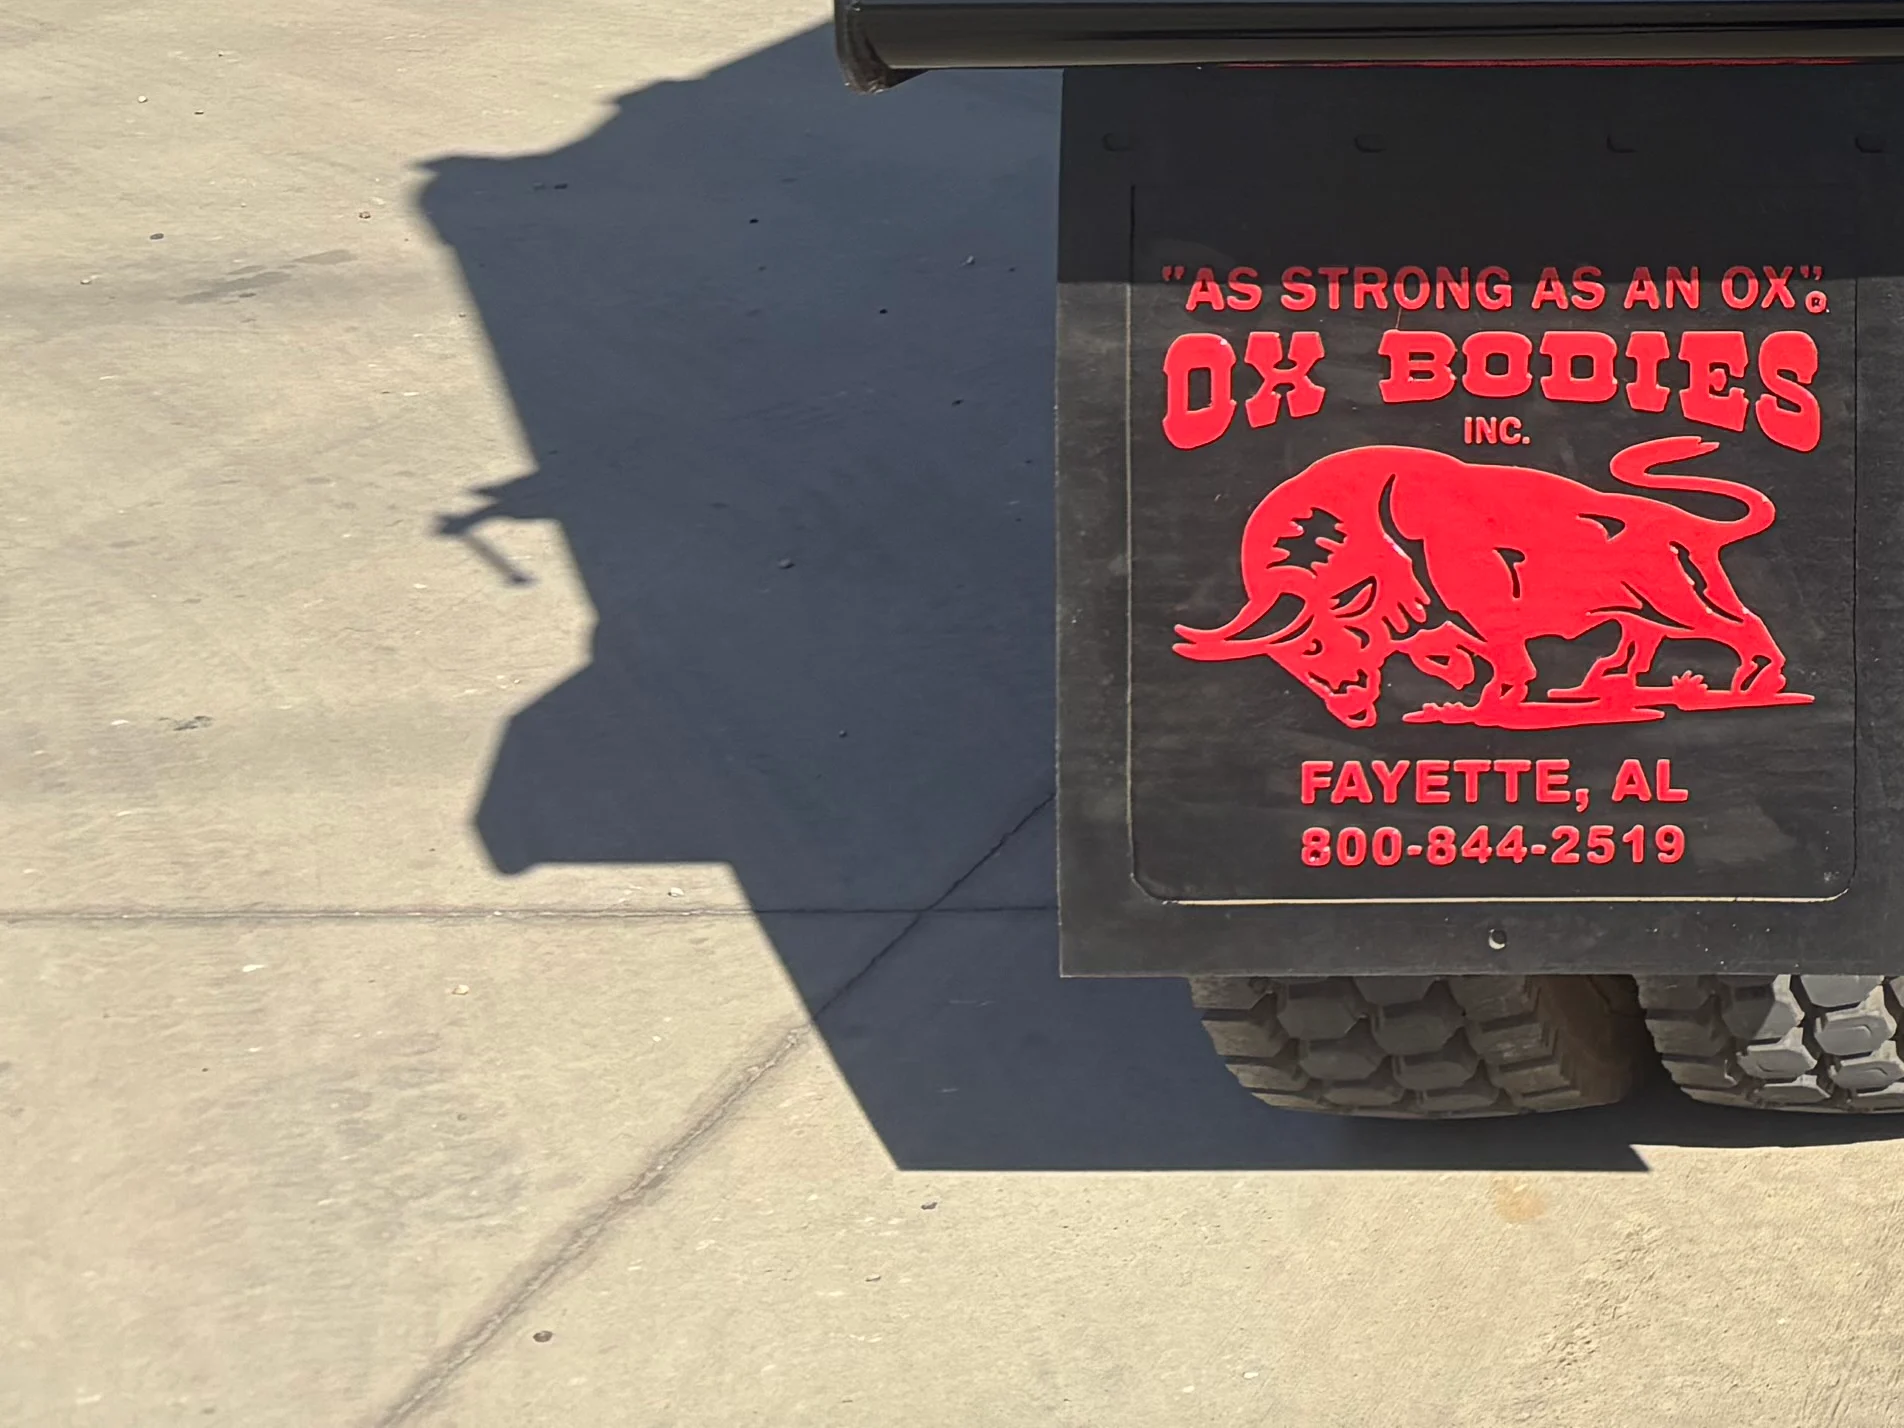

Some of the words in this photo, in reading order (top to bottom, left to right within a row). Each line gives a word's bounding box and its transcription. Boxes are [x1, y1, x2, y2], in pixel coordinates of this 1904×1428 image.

[1280, 266, 1513, 313] STRONG
[1531, 266, 1607, 312] AS
[1623, 267, 1702, 312] AN
[1161, 331, 1327, 451] OX
[1377, 327, 1823, 453] BODIES
[1463, 415, 1532, 447] INC.
[1300, 759, 1591, 815] FAYETTE,
[1611, 759, 1690, 804] AL
[1300, 825, 1686, 869] 800-844-2519
